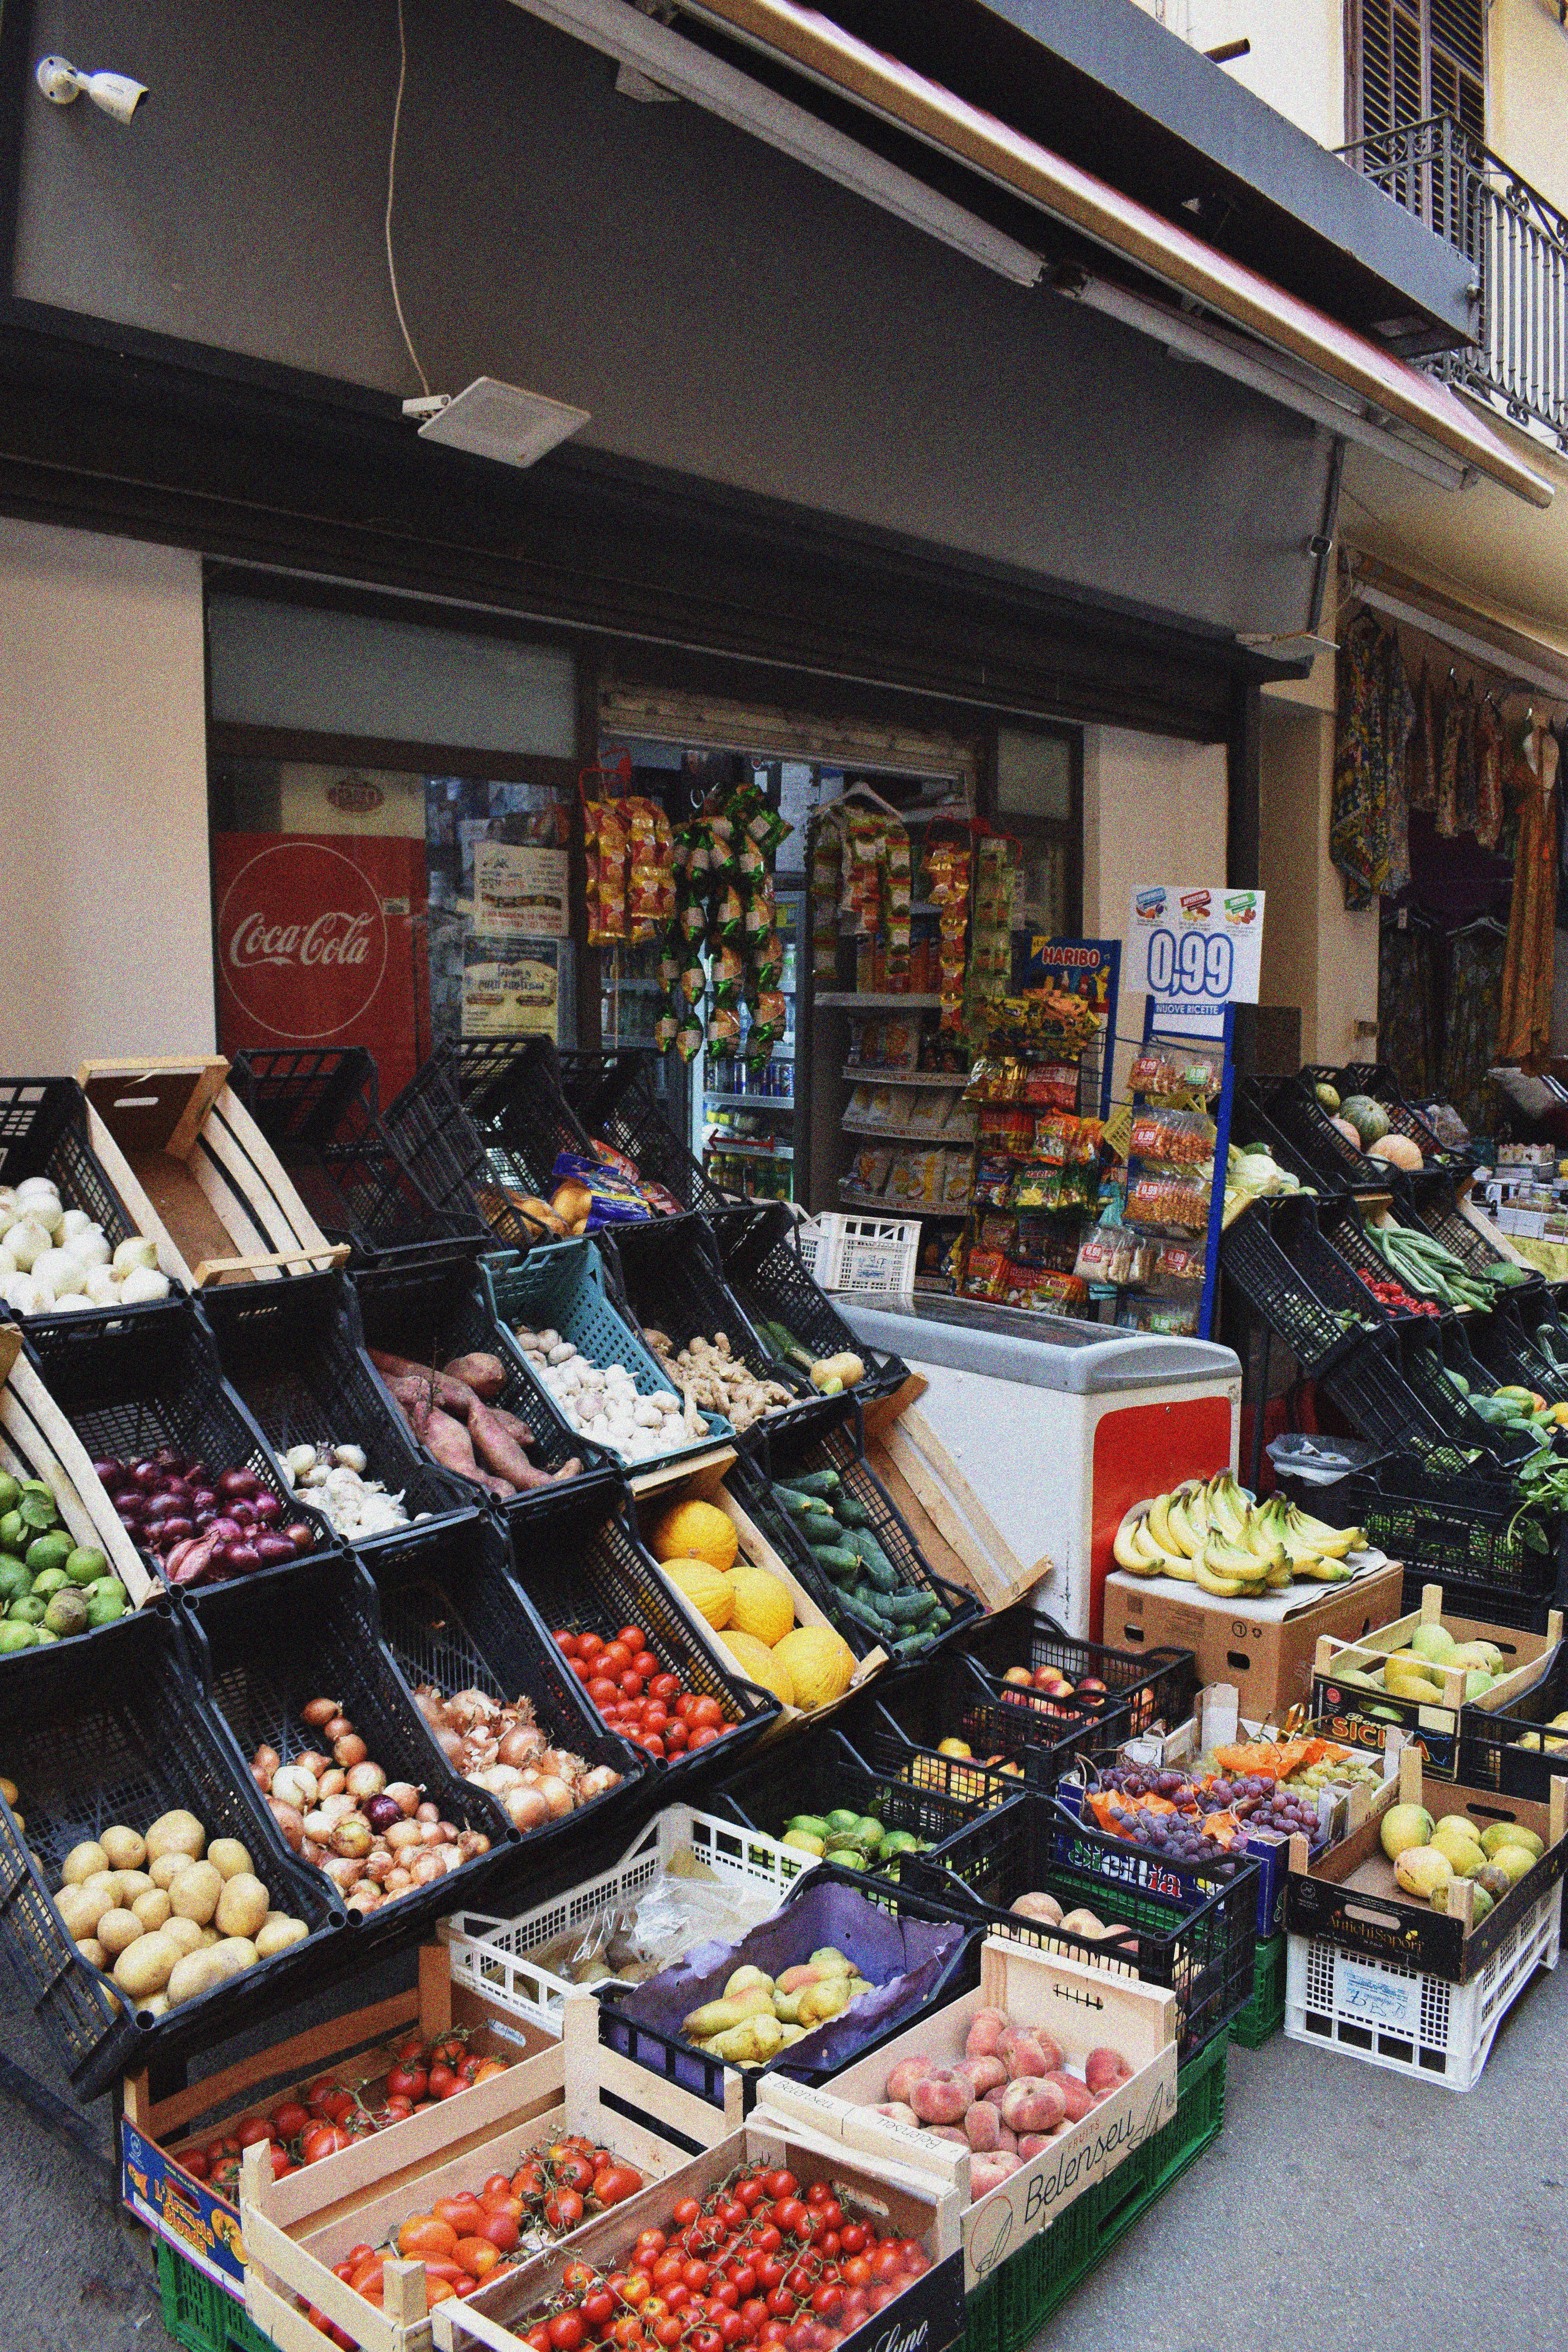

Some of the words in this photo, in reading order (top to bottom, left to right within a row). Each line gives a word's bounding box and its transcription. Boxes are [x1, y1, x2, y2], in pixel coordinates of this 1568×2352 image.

[230, 911, 374, 967] Coca-Cola
[1042, 946, 1101, 968] HARIBO
[1147, 929, 1234, 998] 0,99
[1156, 1004, 1185, 1014] NUOVE
[1187, 1005, 1218, 1015] RICETTE
[1332, 1716, 1430, 1762] SICIA
[1024, 2110, 1134, 2225] Belenseu
